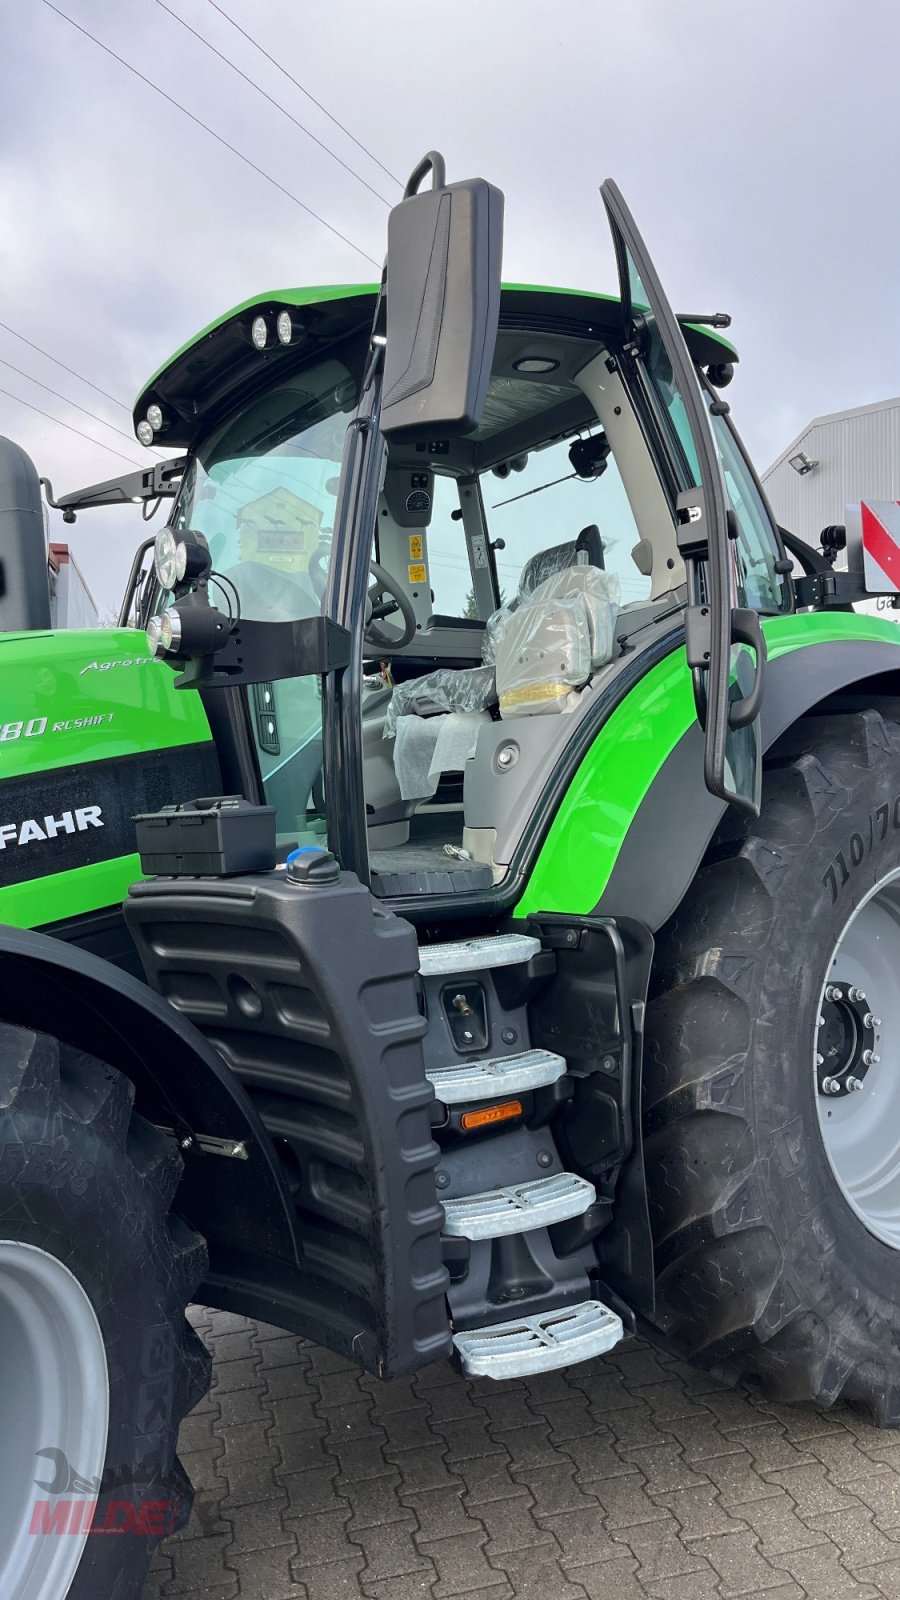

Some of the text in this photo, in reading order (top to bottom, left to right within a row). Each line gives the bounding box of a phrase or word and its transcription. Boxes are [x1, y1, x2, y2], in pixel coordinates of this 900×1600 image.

[80, 656, 162, 676] Agrotro
[0, 717, 48, 742] 80
[0, 805, 104, 849] FAHR
